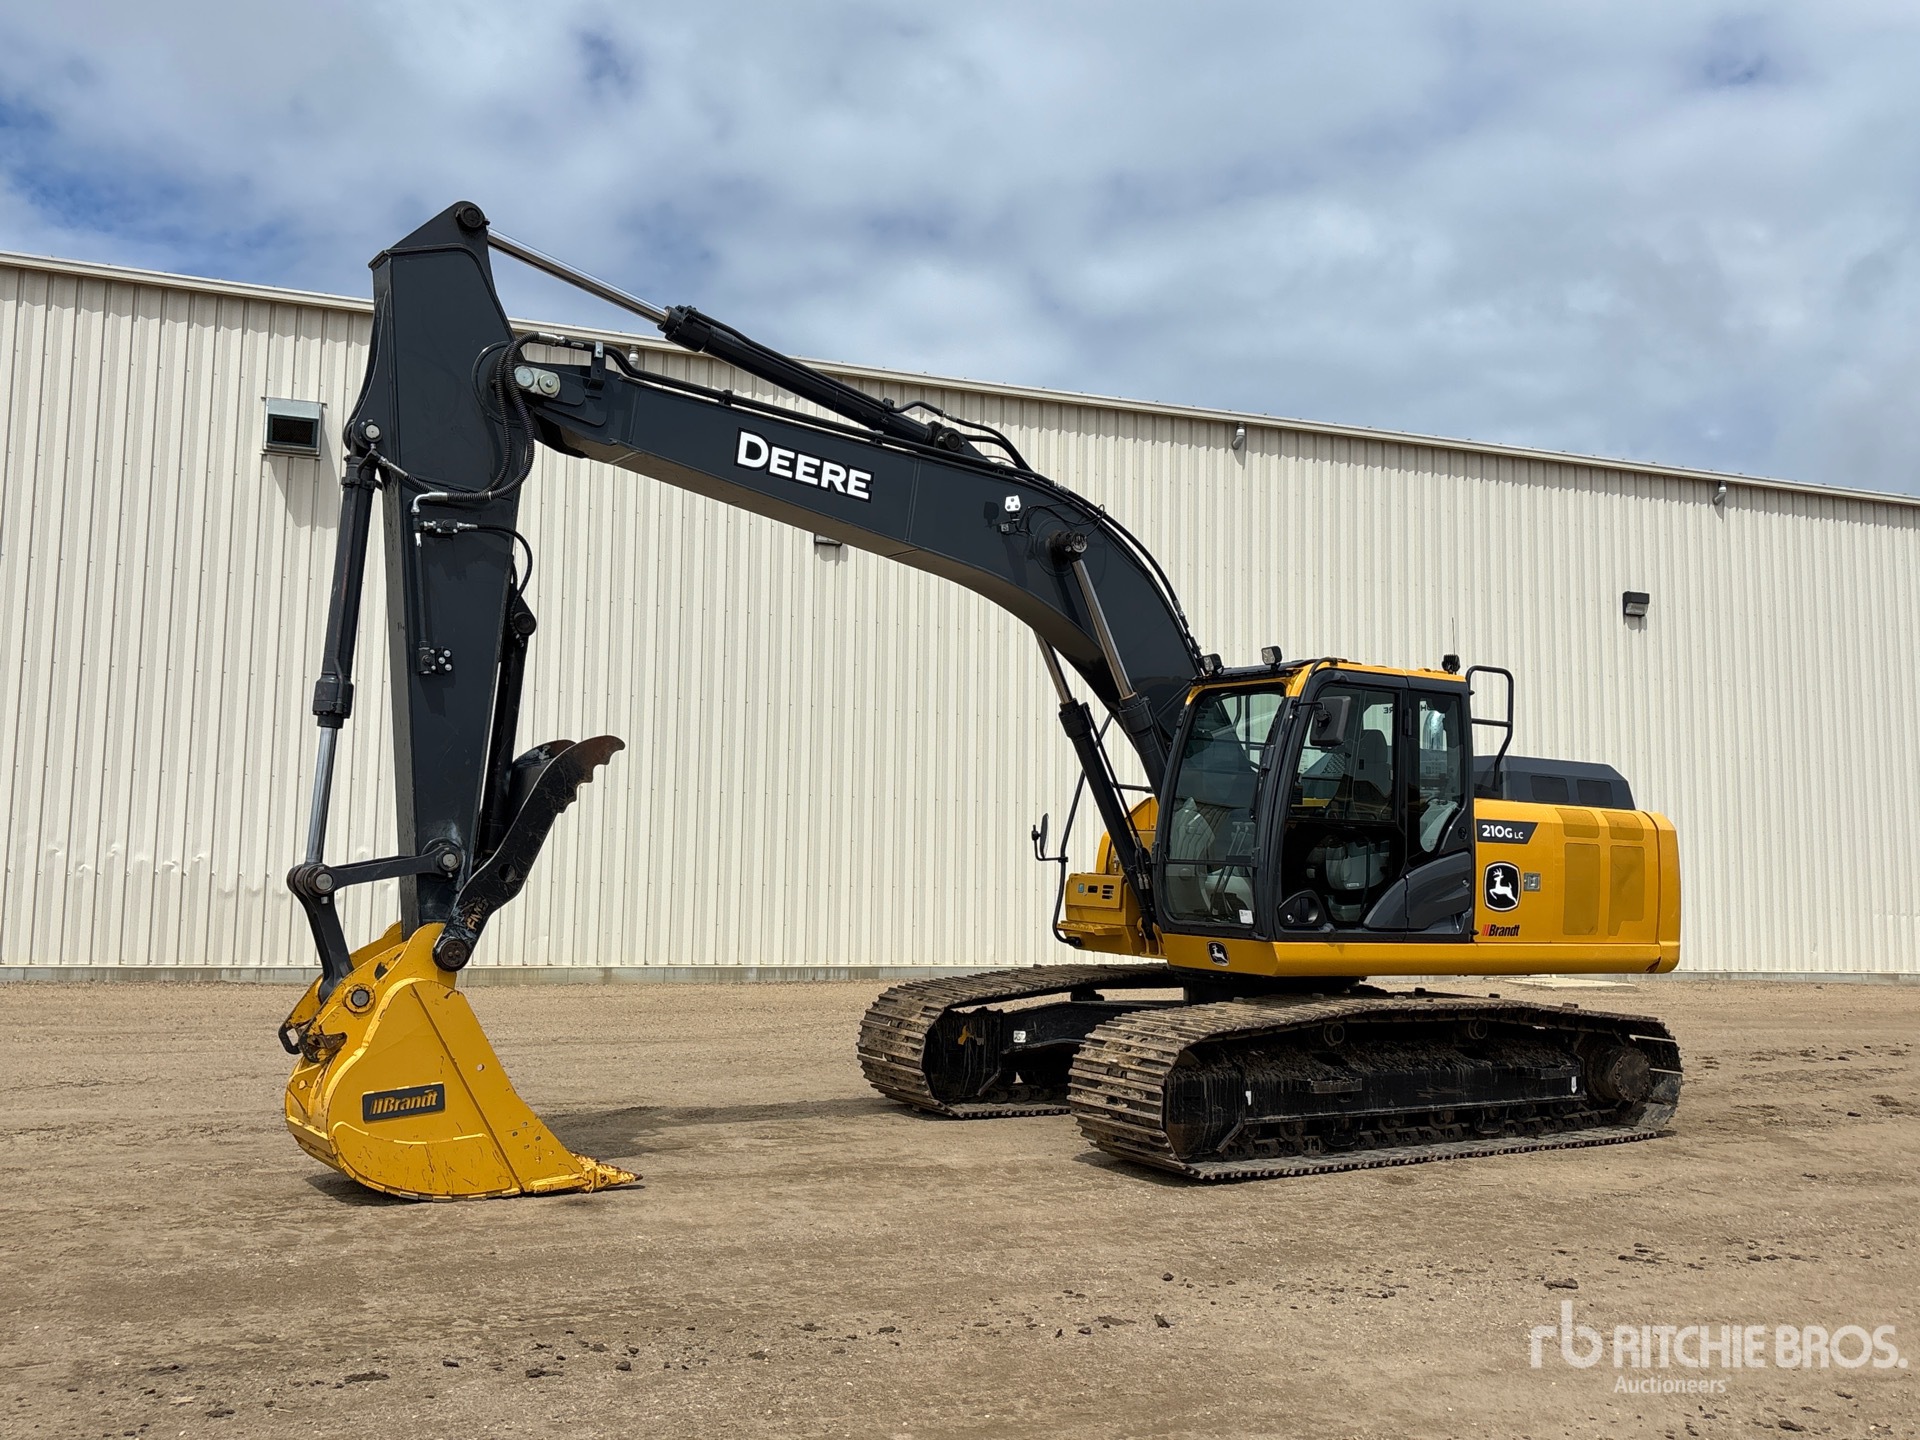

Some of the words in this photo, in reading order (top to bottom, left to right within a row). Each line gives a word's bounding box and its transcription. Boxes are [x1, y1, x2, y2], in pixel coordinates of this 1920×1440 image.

[736, 430, 872, 500] DEERE
[1481, 824, 1513, 839] 210G
[1514, 831, 1524, 839] LC
[1488, 924, 1520, 937] Brandt
[381, 1089, 438, 1114] Brandt
